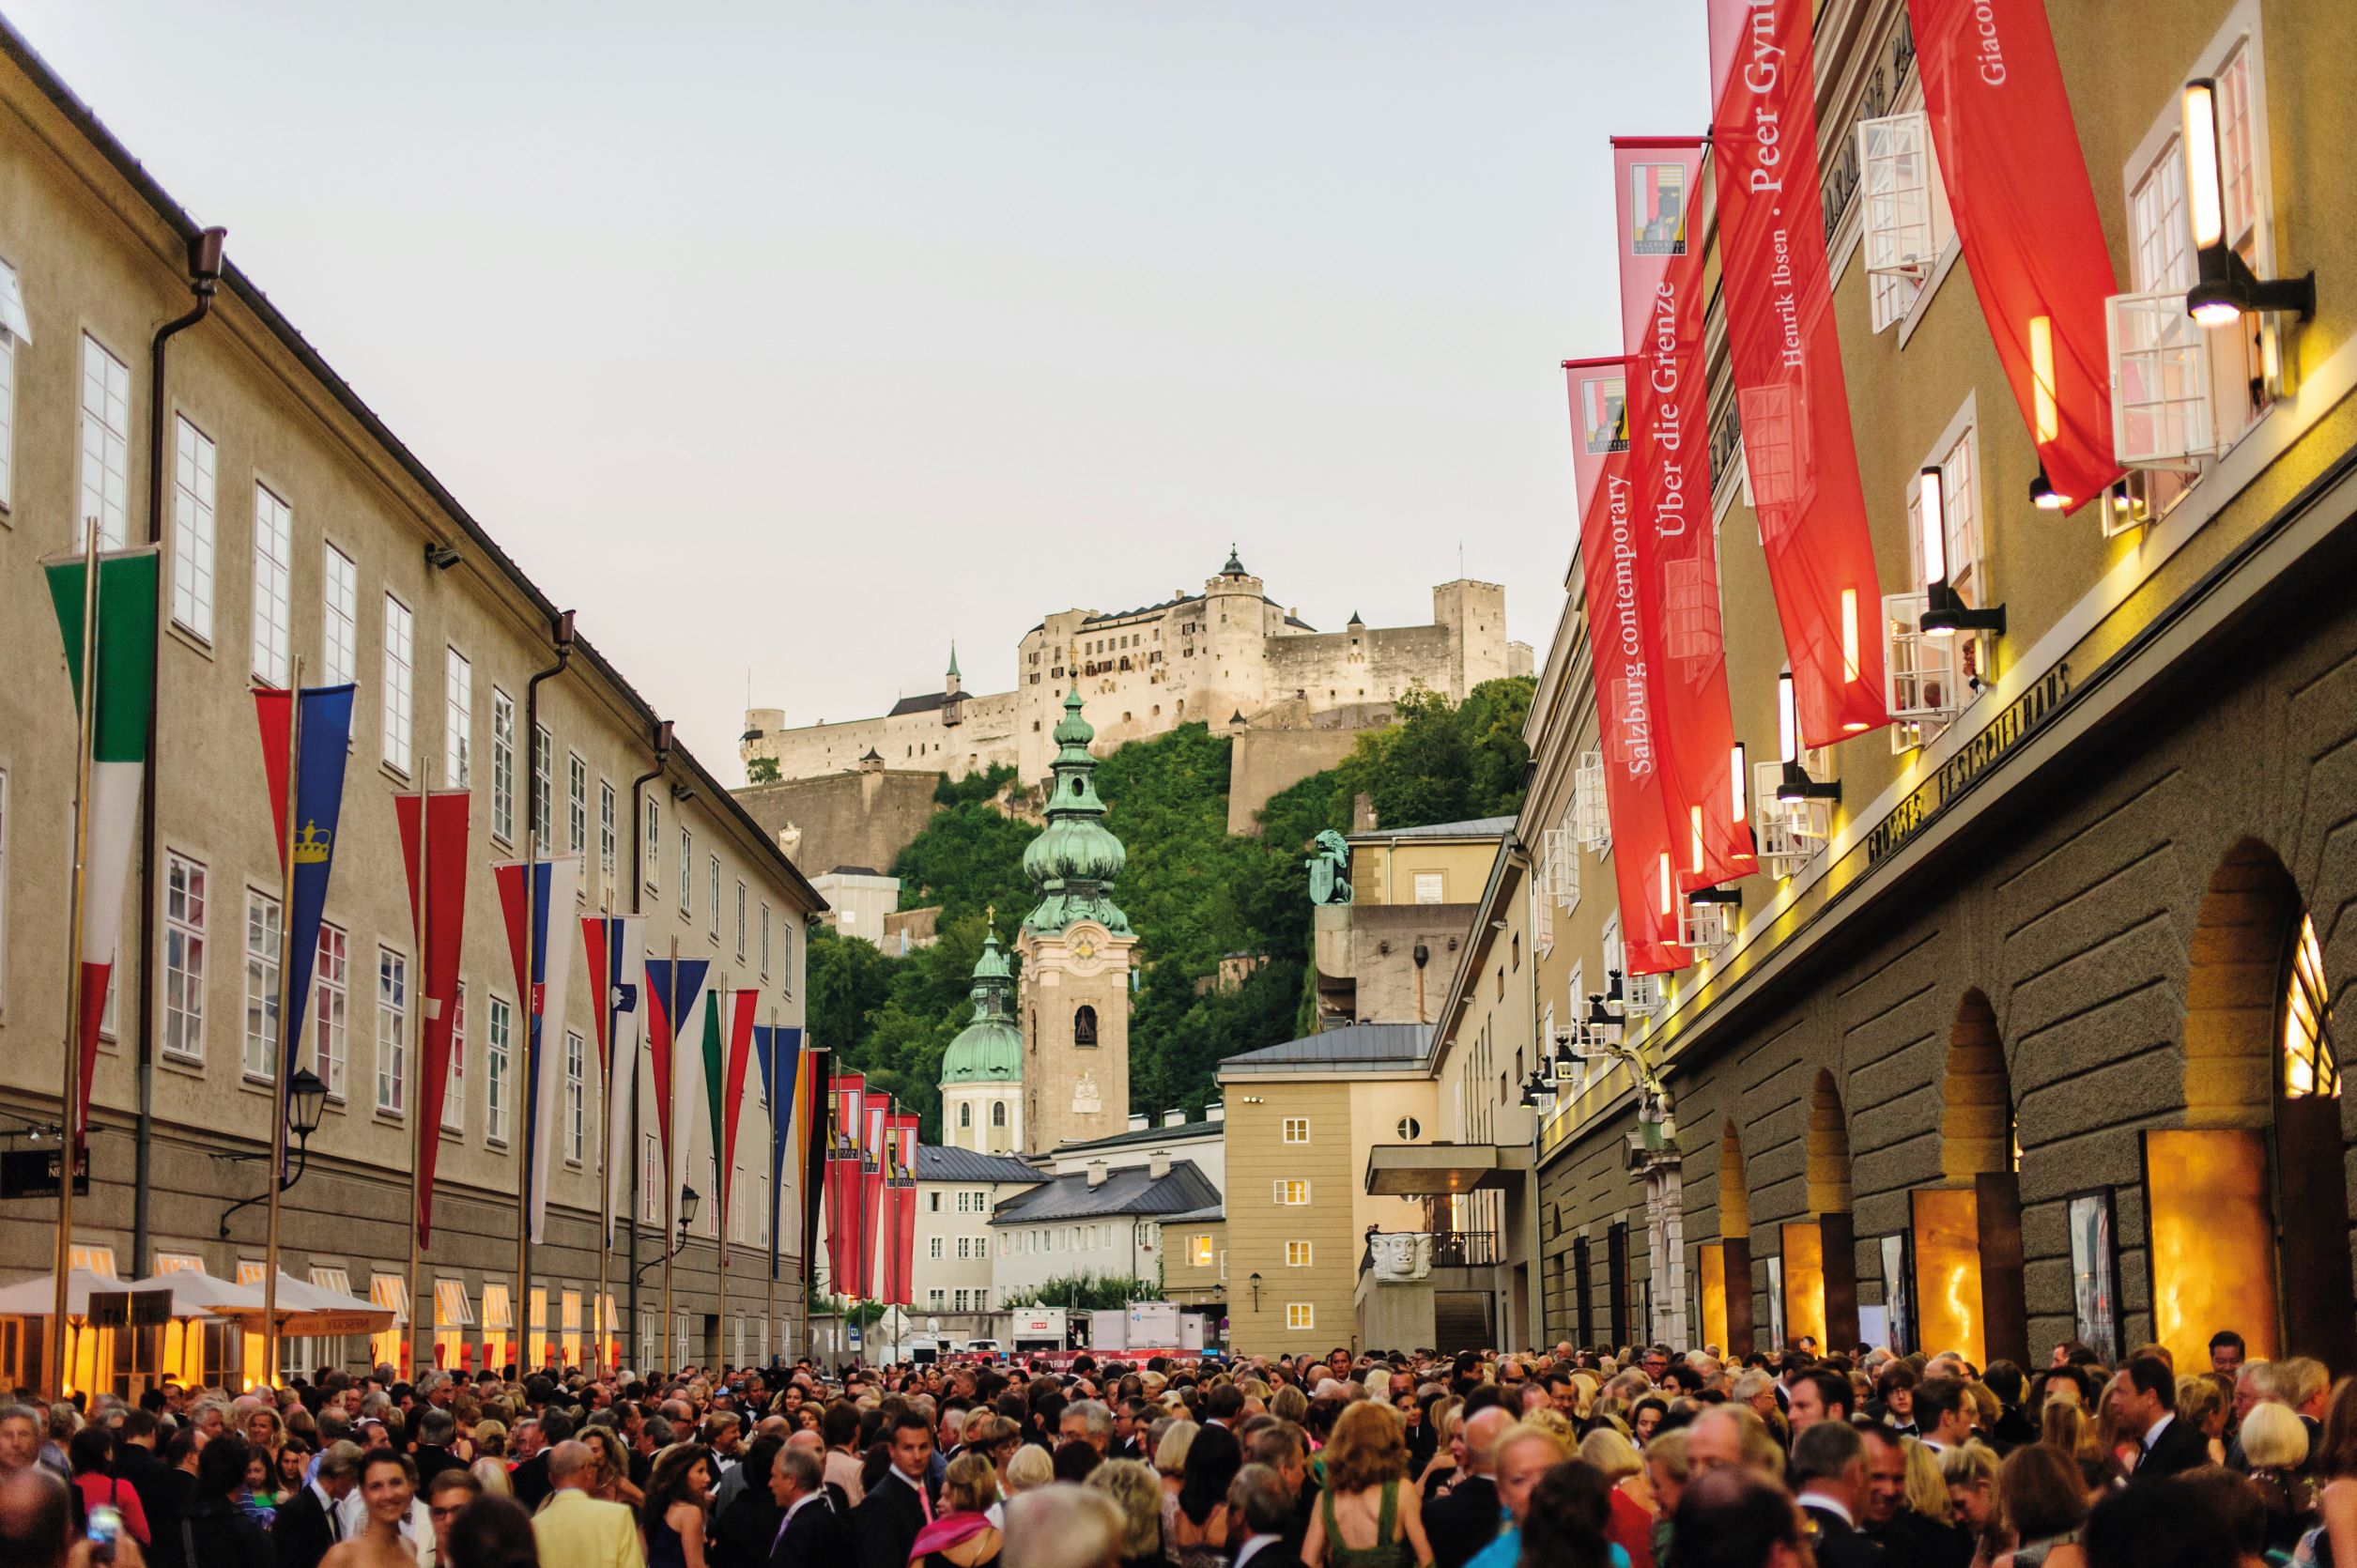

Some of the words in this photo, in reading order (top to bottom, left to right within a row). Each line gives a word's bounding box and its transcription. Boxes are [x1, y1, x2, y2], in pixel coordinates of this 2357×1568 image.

[1974, 0, 2006, 85] Giaco
[1750, 107, 1782, 194] Peer
[1772, 228, 1792, 287] Ibsen
[1651, 281, 1678, 393] Grenze
[1775, 292, 1803, 368] Henrik
[1653, 404, 1681, 451] die
[1655, 459, 1686, 539] Über
[1609, 473, 1639, 655] contemporary
[1623, 662, 1651, 774] Salzburg
[1938, 663, 2070, 806] FESTSPIELHAUS
